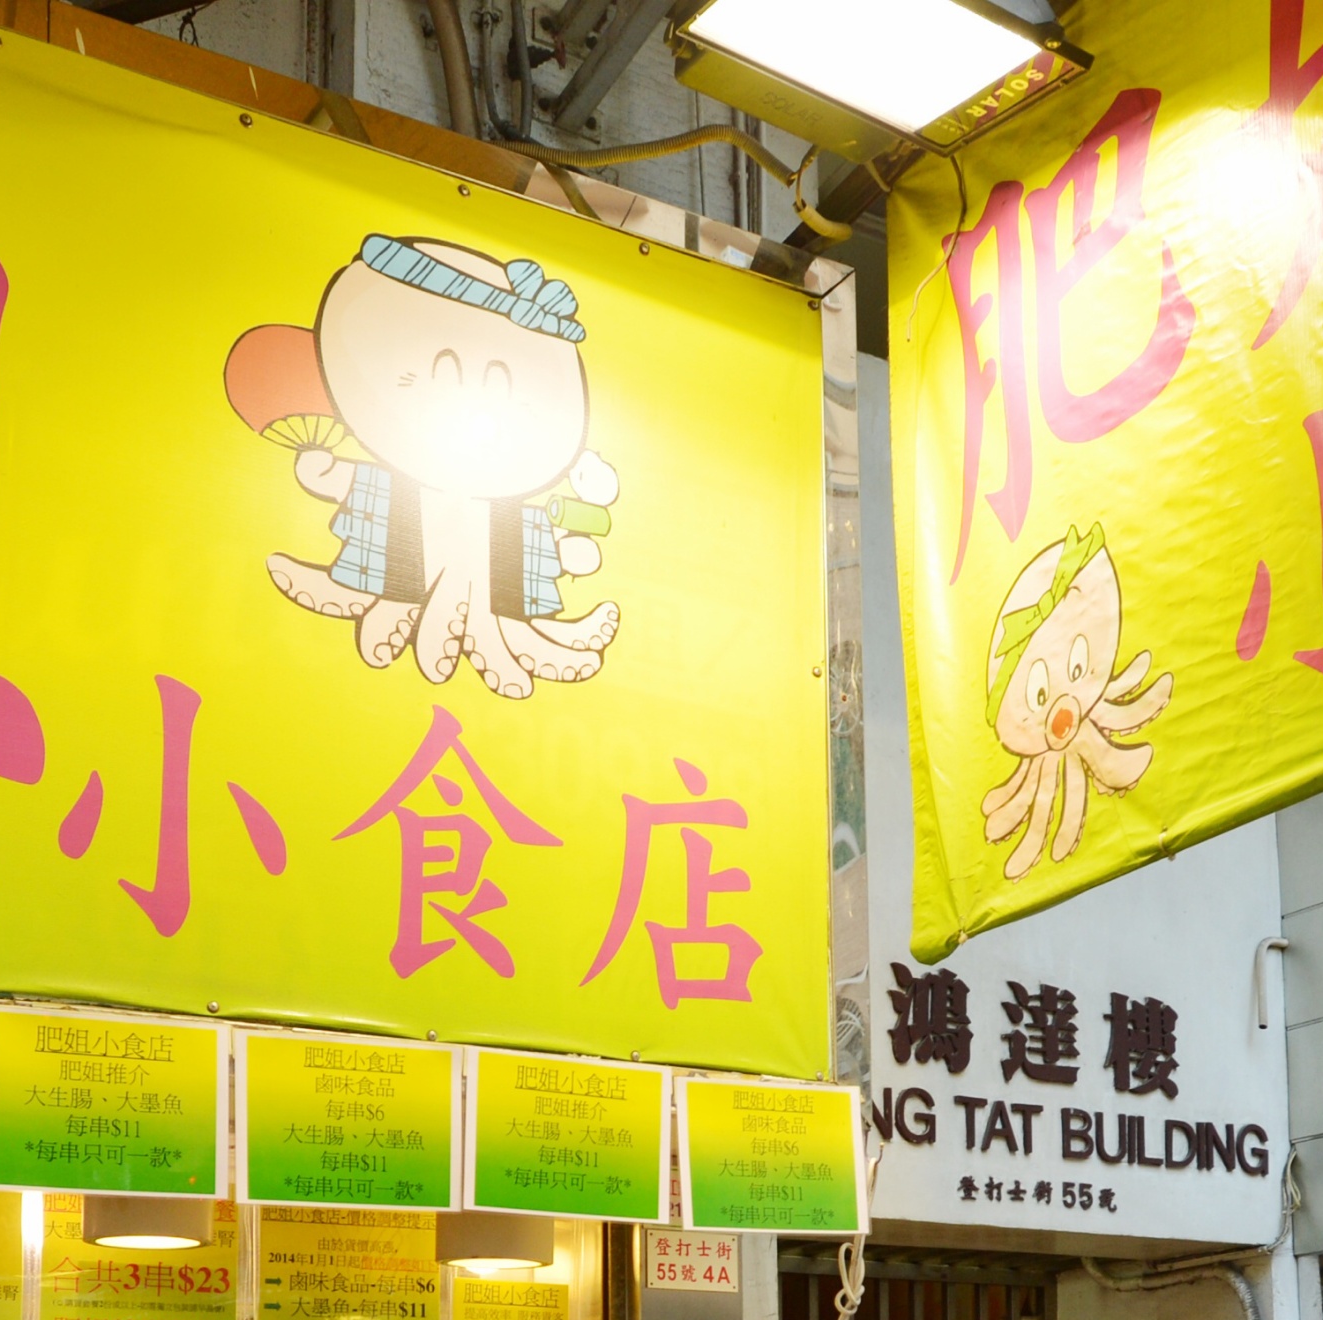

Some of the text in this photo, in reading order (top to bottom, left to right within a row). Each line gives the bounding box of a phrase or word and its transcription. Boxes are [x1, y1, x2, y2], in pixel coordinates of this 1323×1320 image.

[965, 68, 1044, 118] SOLAR
[58, 673, 764, 1010] 小食店
[35, 1024, 175, 1063] 肥姐小食店
[888, 962, 1179, 1099] 鴻達樓
[58, 1058, 151, 1088] 肥姐推介
[303, 1045, 406, 1076] 肥姐小食店
[314, 1073, 396, 1099] 鹵味食品
[514, 1064, 628, 1101] 肥姐小食店
[24, 1086, 184, 1116] 大生腸、大墨魚
[324, 1098, 385, 1123] 每串$6
[533, 1095, 608, 1122] 肥姐推介
[732, 1089, 815, 1115] 肥姐小食店
[64, 1113, 142, 1140] 每串$11
[283, 1123, 426, 1152] 大生腸、大墨魚
[505, 1117, 634, 1149] 大生腸、大墨魚
[741, 1114, 808, 1137] 鹵味食品
[953, 1094, 1044, 1155] TAT
[1061, 1107, 1270, 1178] BUILDING
[537, 1143, 599, 1169] 每串$11
[749, 1137, 800, 1158] 每串$6
[319, 1150, 388, 1175] 每串$11
[717, 1159, 834, 1183] 大生腸、大墨魚
[749, 1182, 803, 1203] 每串$11
[655, 1237, 732, 1260] 登打士街
[47, 1256, 232, 1297] 合共3串$23
[463, 1282, 560, 1309] 肥姐小食店
